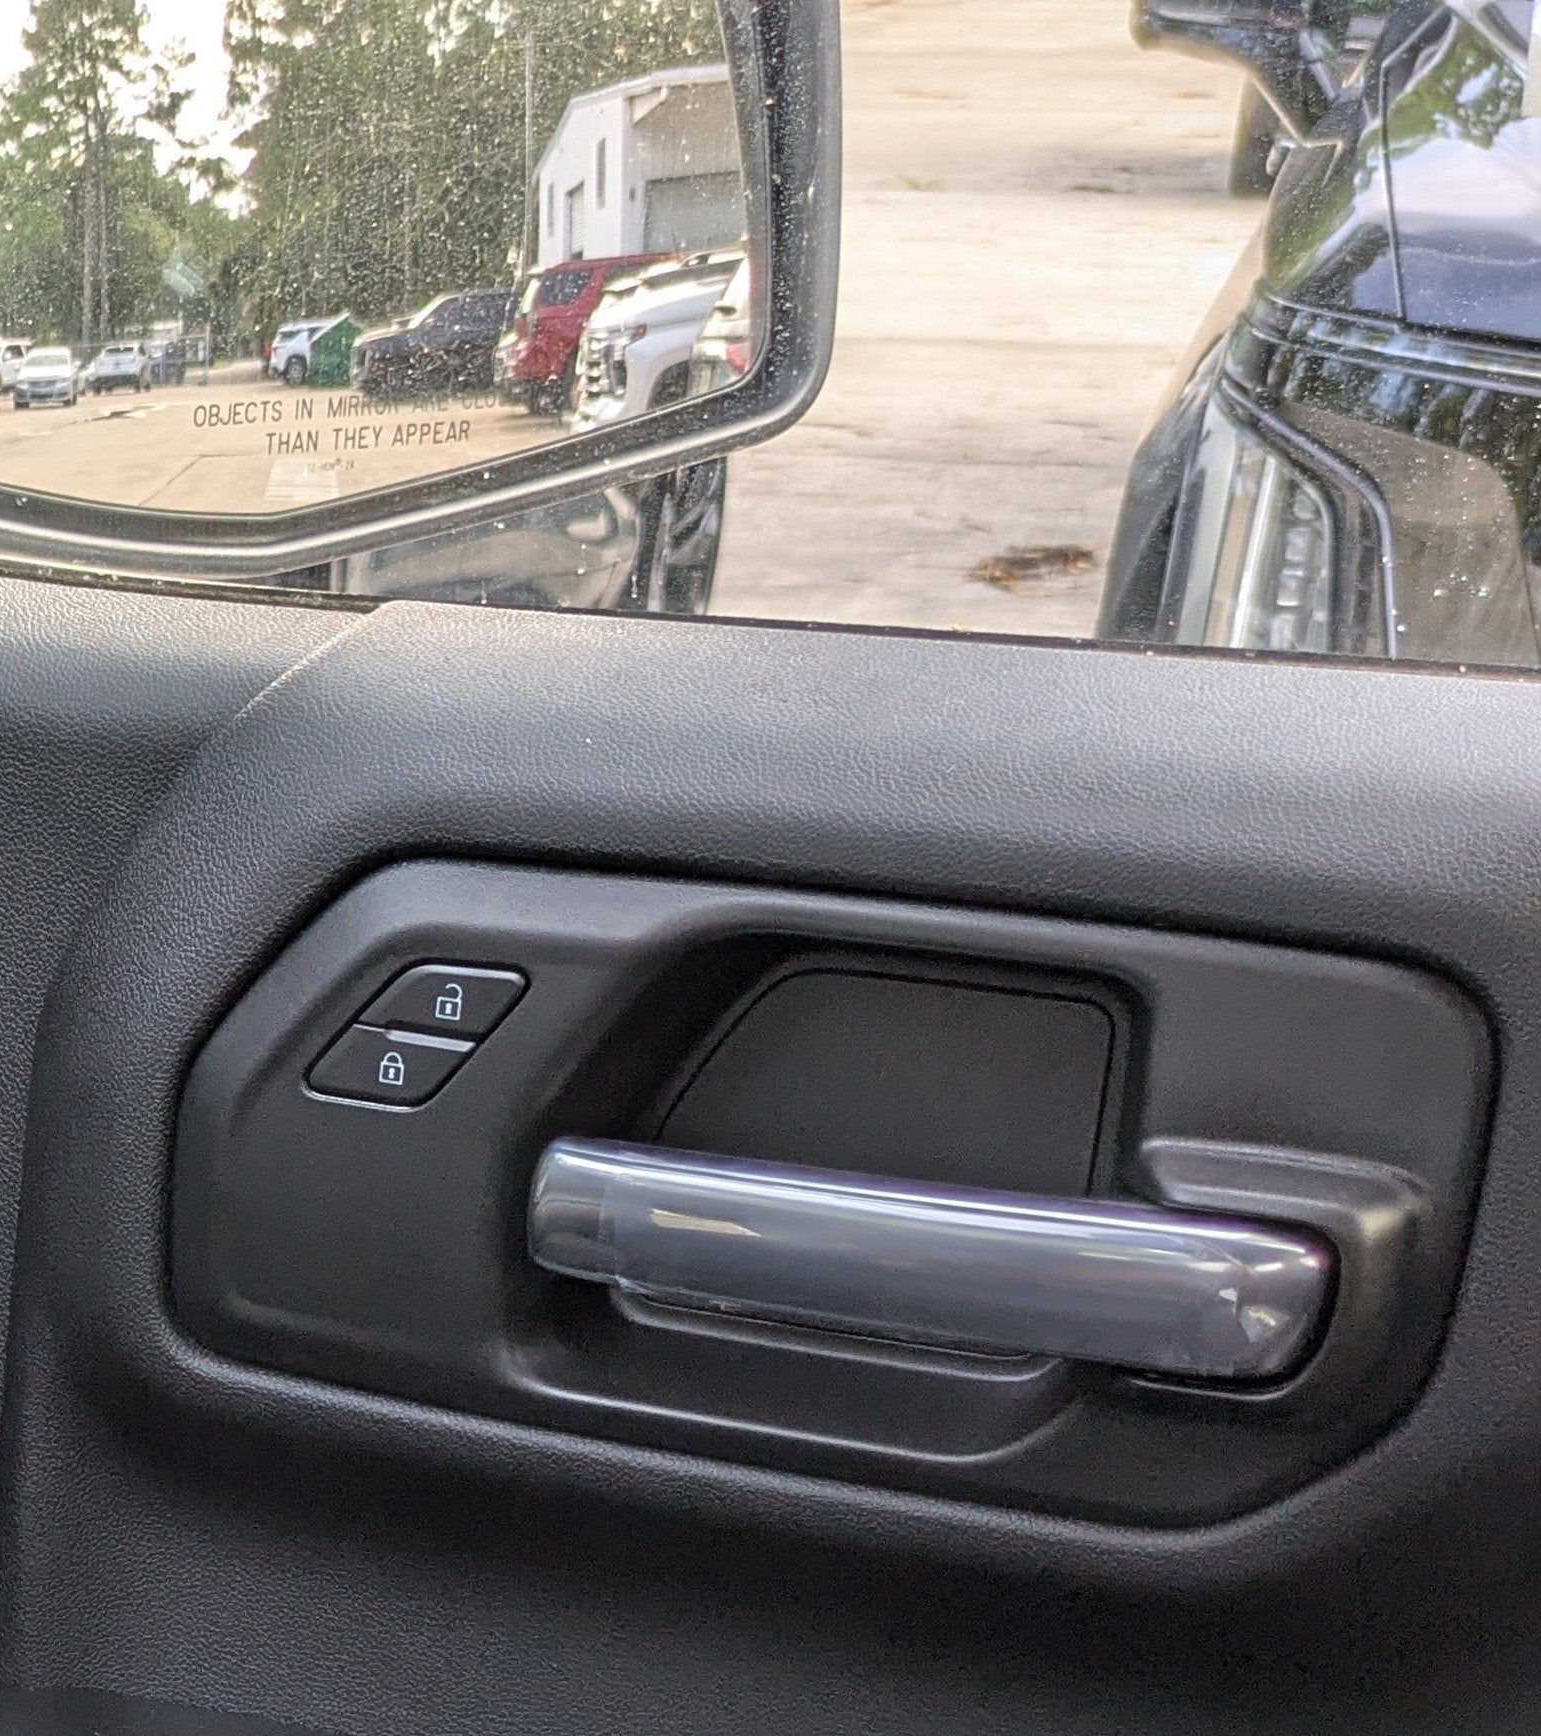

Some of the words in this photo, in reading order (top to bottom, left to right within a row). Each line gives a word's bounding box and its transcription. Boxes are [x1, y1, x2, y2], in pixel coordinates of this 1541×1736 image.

[193, 400, 283, 427] OBJECTS
[295, 398, 313, 420] IN
[264, 430, 319, 455] THAN
[332, 426, 383, 450] THEY
[391, 420, 471, 447] APPEAR
